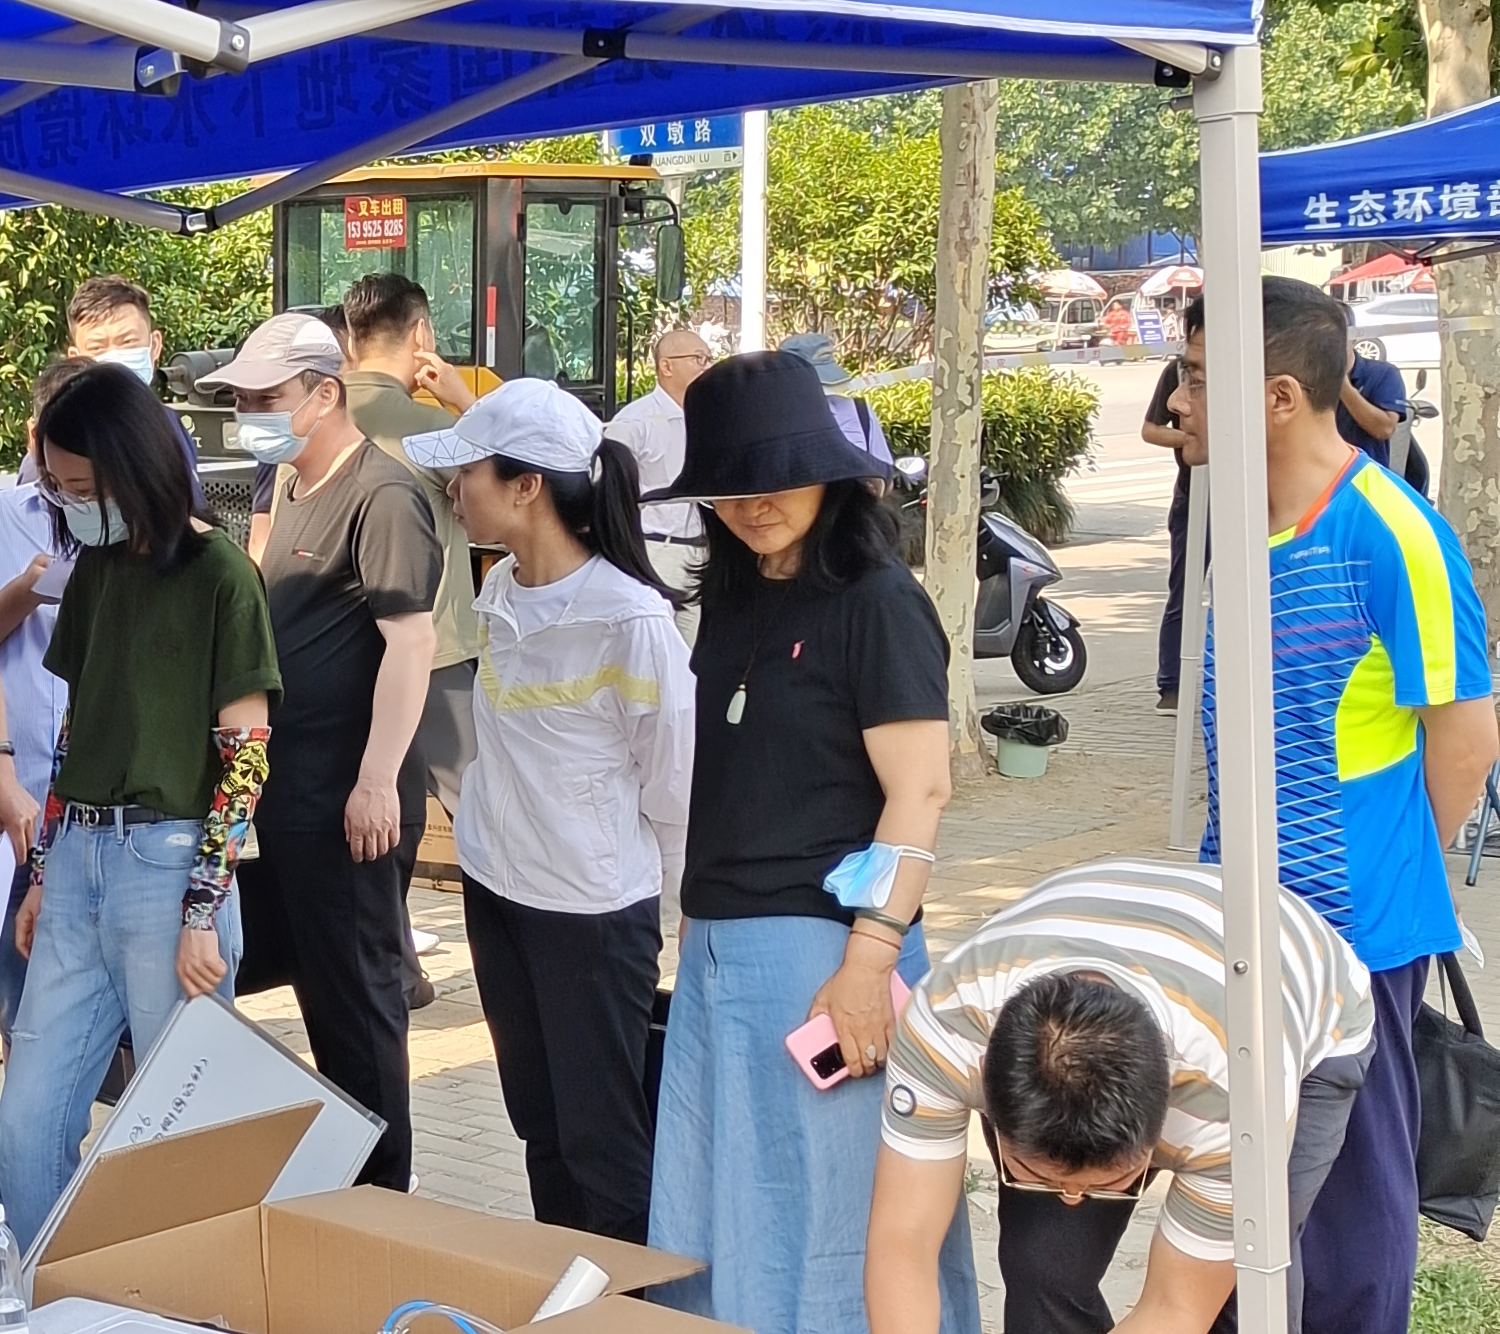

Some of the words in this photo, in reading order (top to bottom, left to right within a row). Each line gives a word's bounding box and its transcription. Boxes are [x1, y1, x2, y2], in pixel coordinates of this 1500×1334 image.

[640, 118, 711, 147] 双墩路
[652, 154, 695, 166] UANGDUN
[700, 153, 710, 163] LU
[358, 198, 404, 217] 叉车出租
